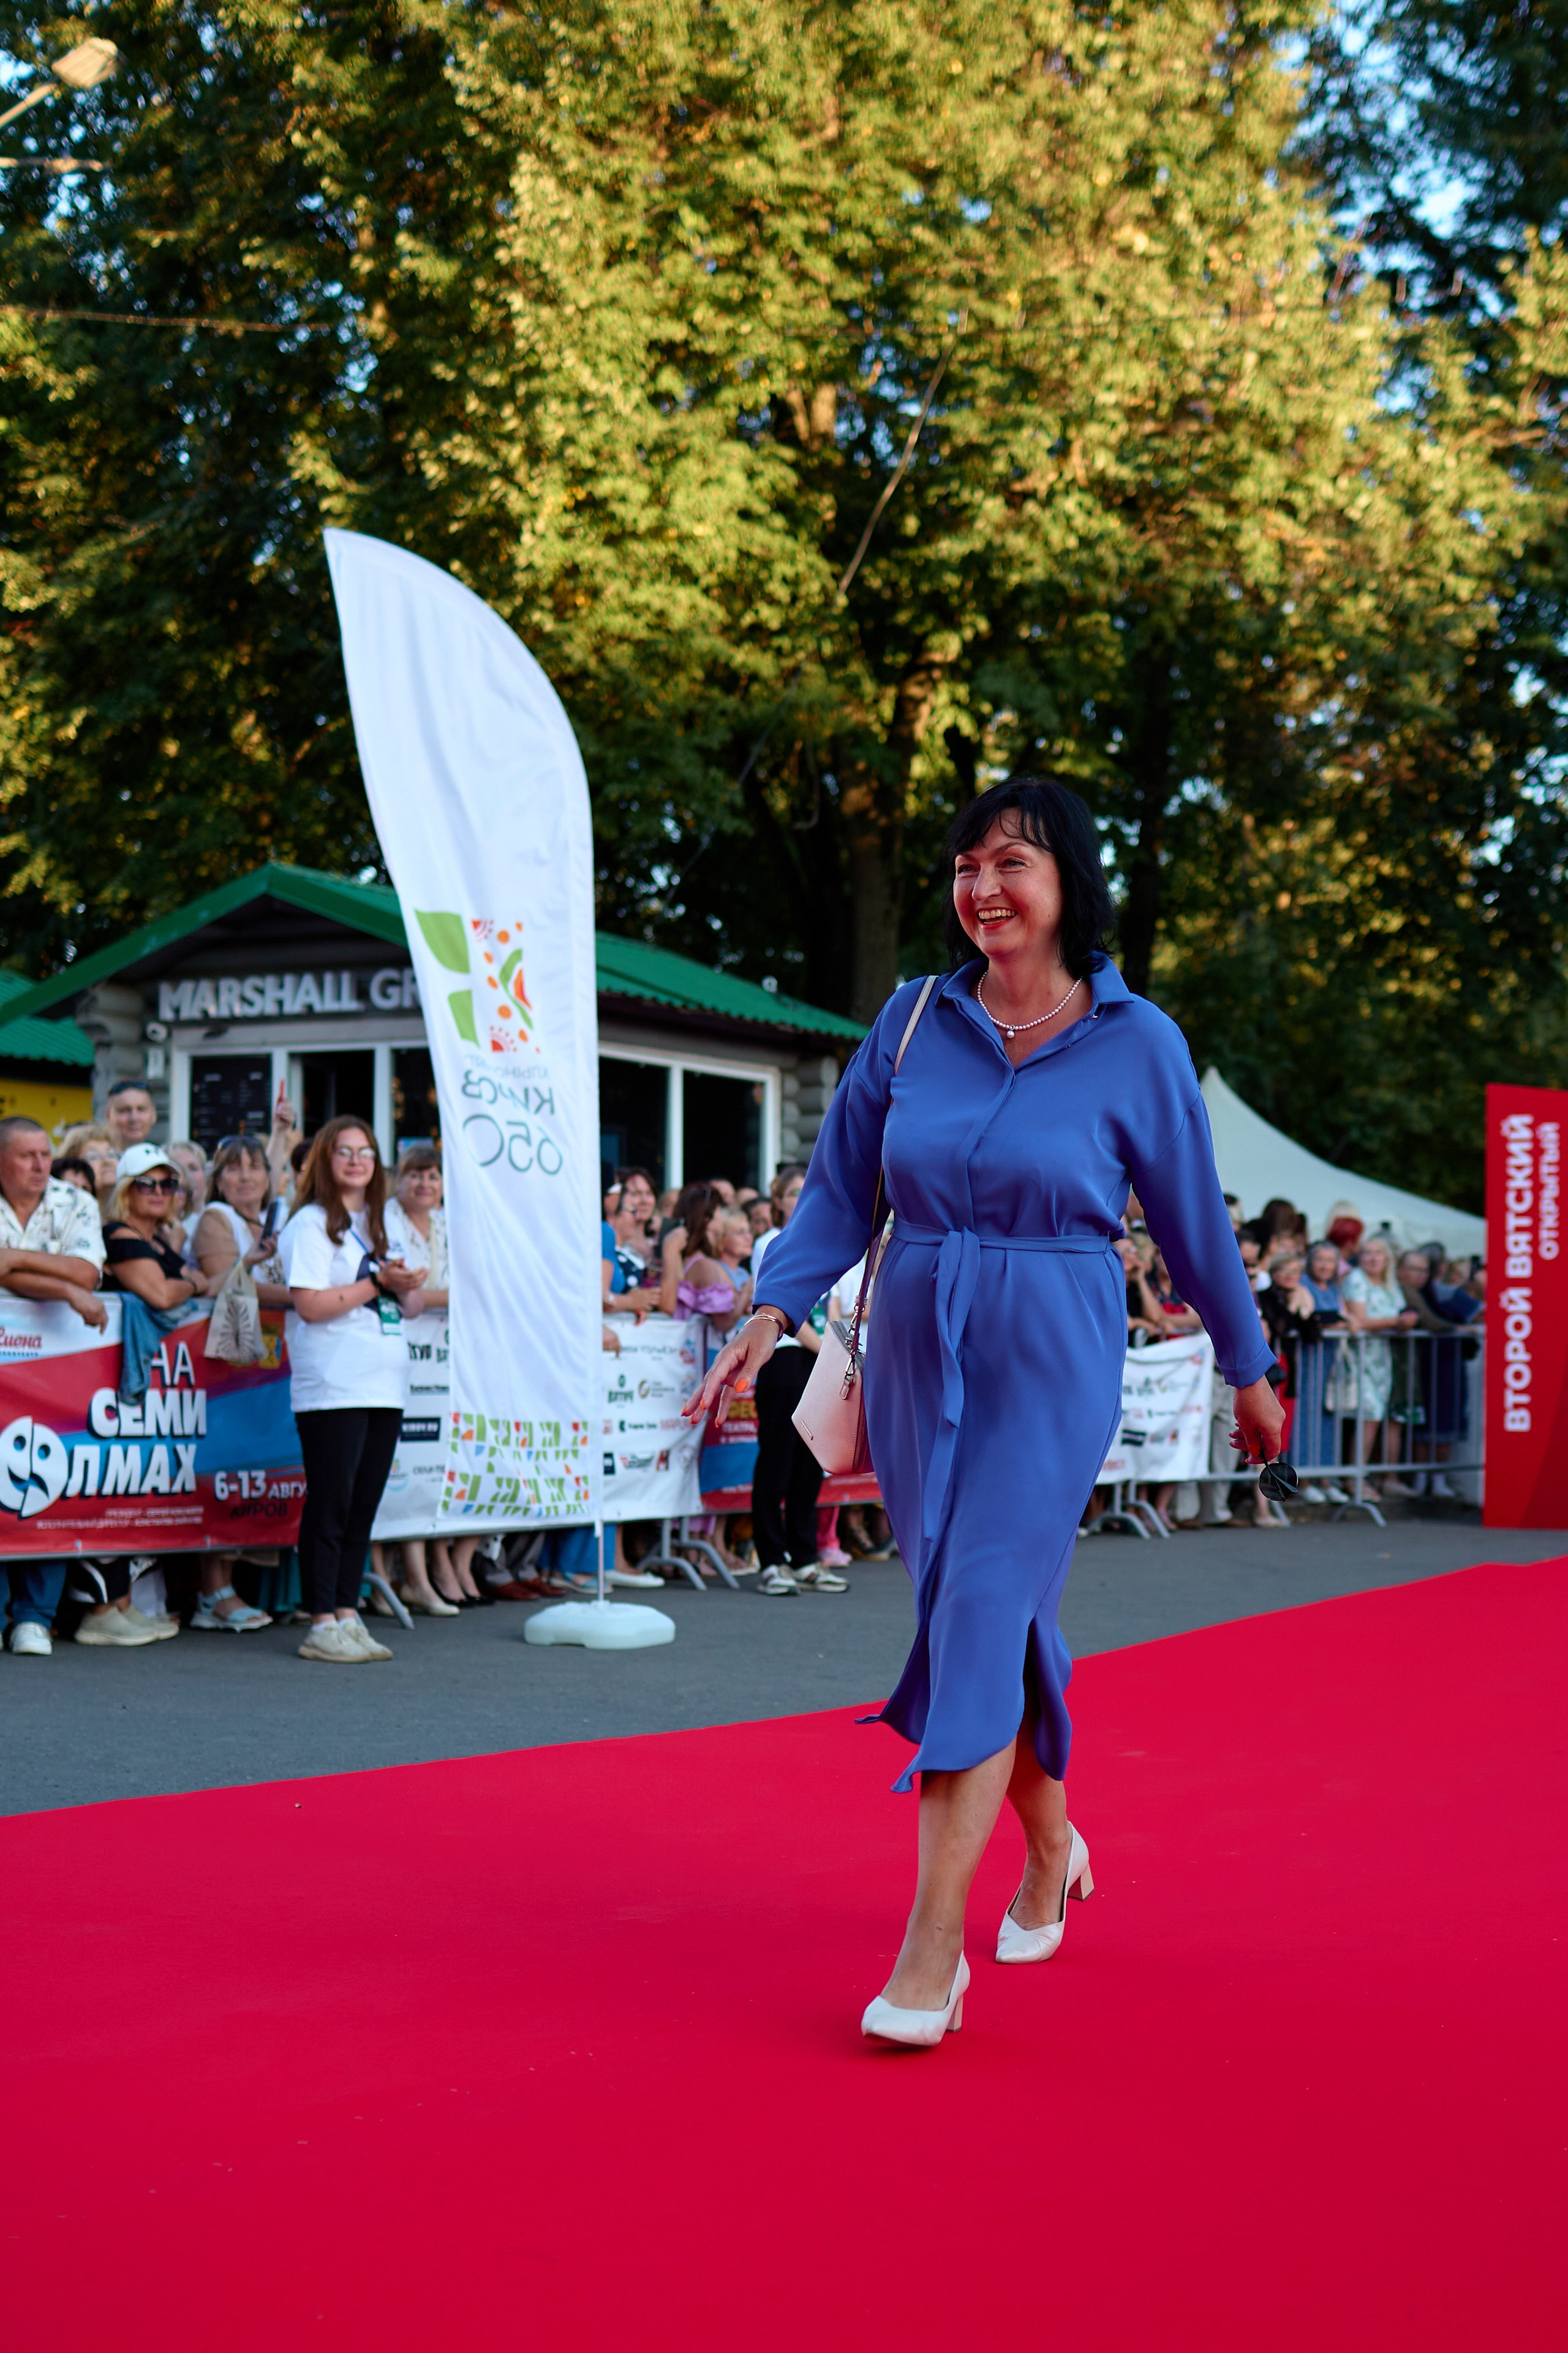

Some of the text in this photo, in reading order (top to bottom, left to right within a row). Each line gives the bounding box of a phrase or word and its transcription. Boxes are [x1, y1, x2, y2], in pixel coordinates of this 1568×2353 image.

[158, 971, 366, 1022] MARSHALL
[1536, 1122, 1561, 1260] ОТКРЫТЫЙ
[1499, 1114, 1534, 1432] ВТОРОЙ ВЯТСКИЙ
[90, 1387, 207, 1438] СЕМИ
[214, 1470, 267, 1501] 6-13
